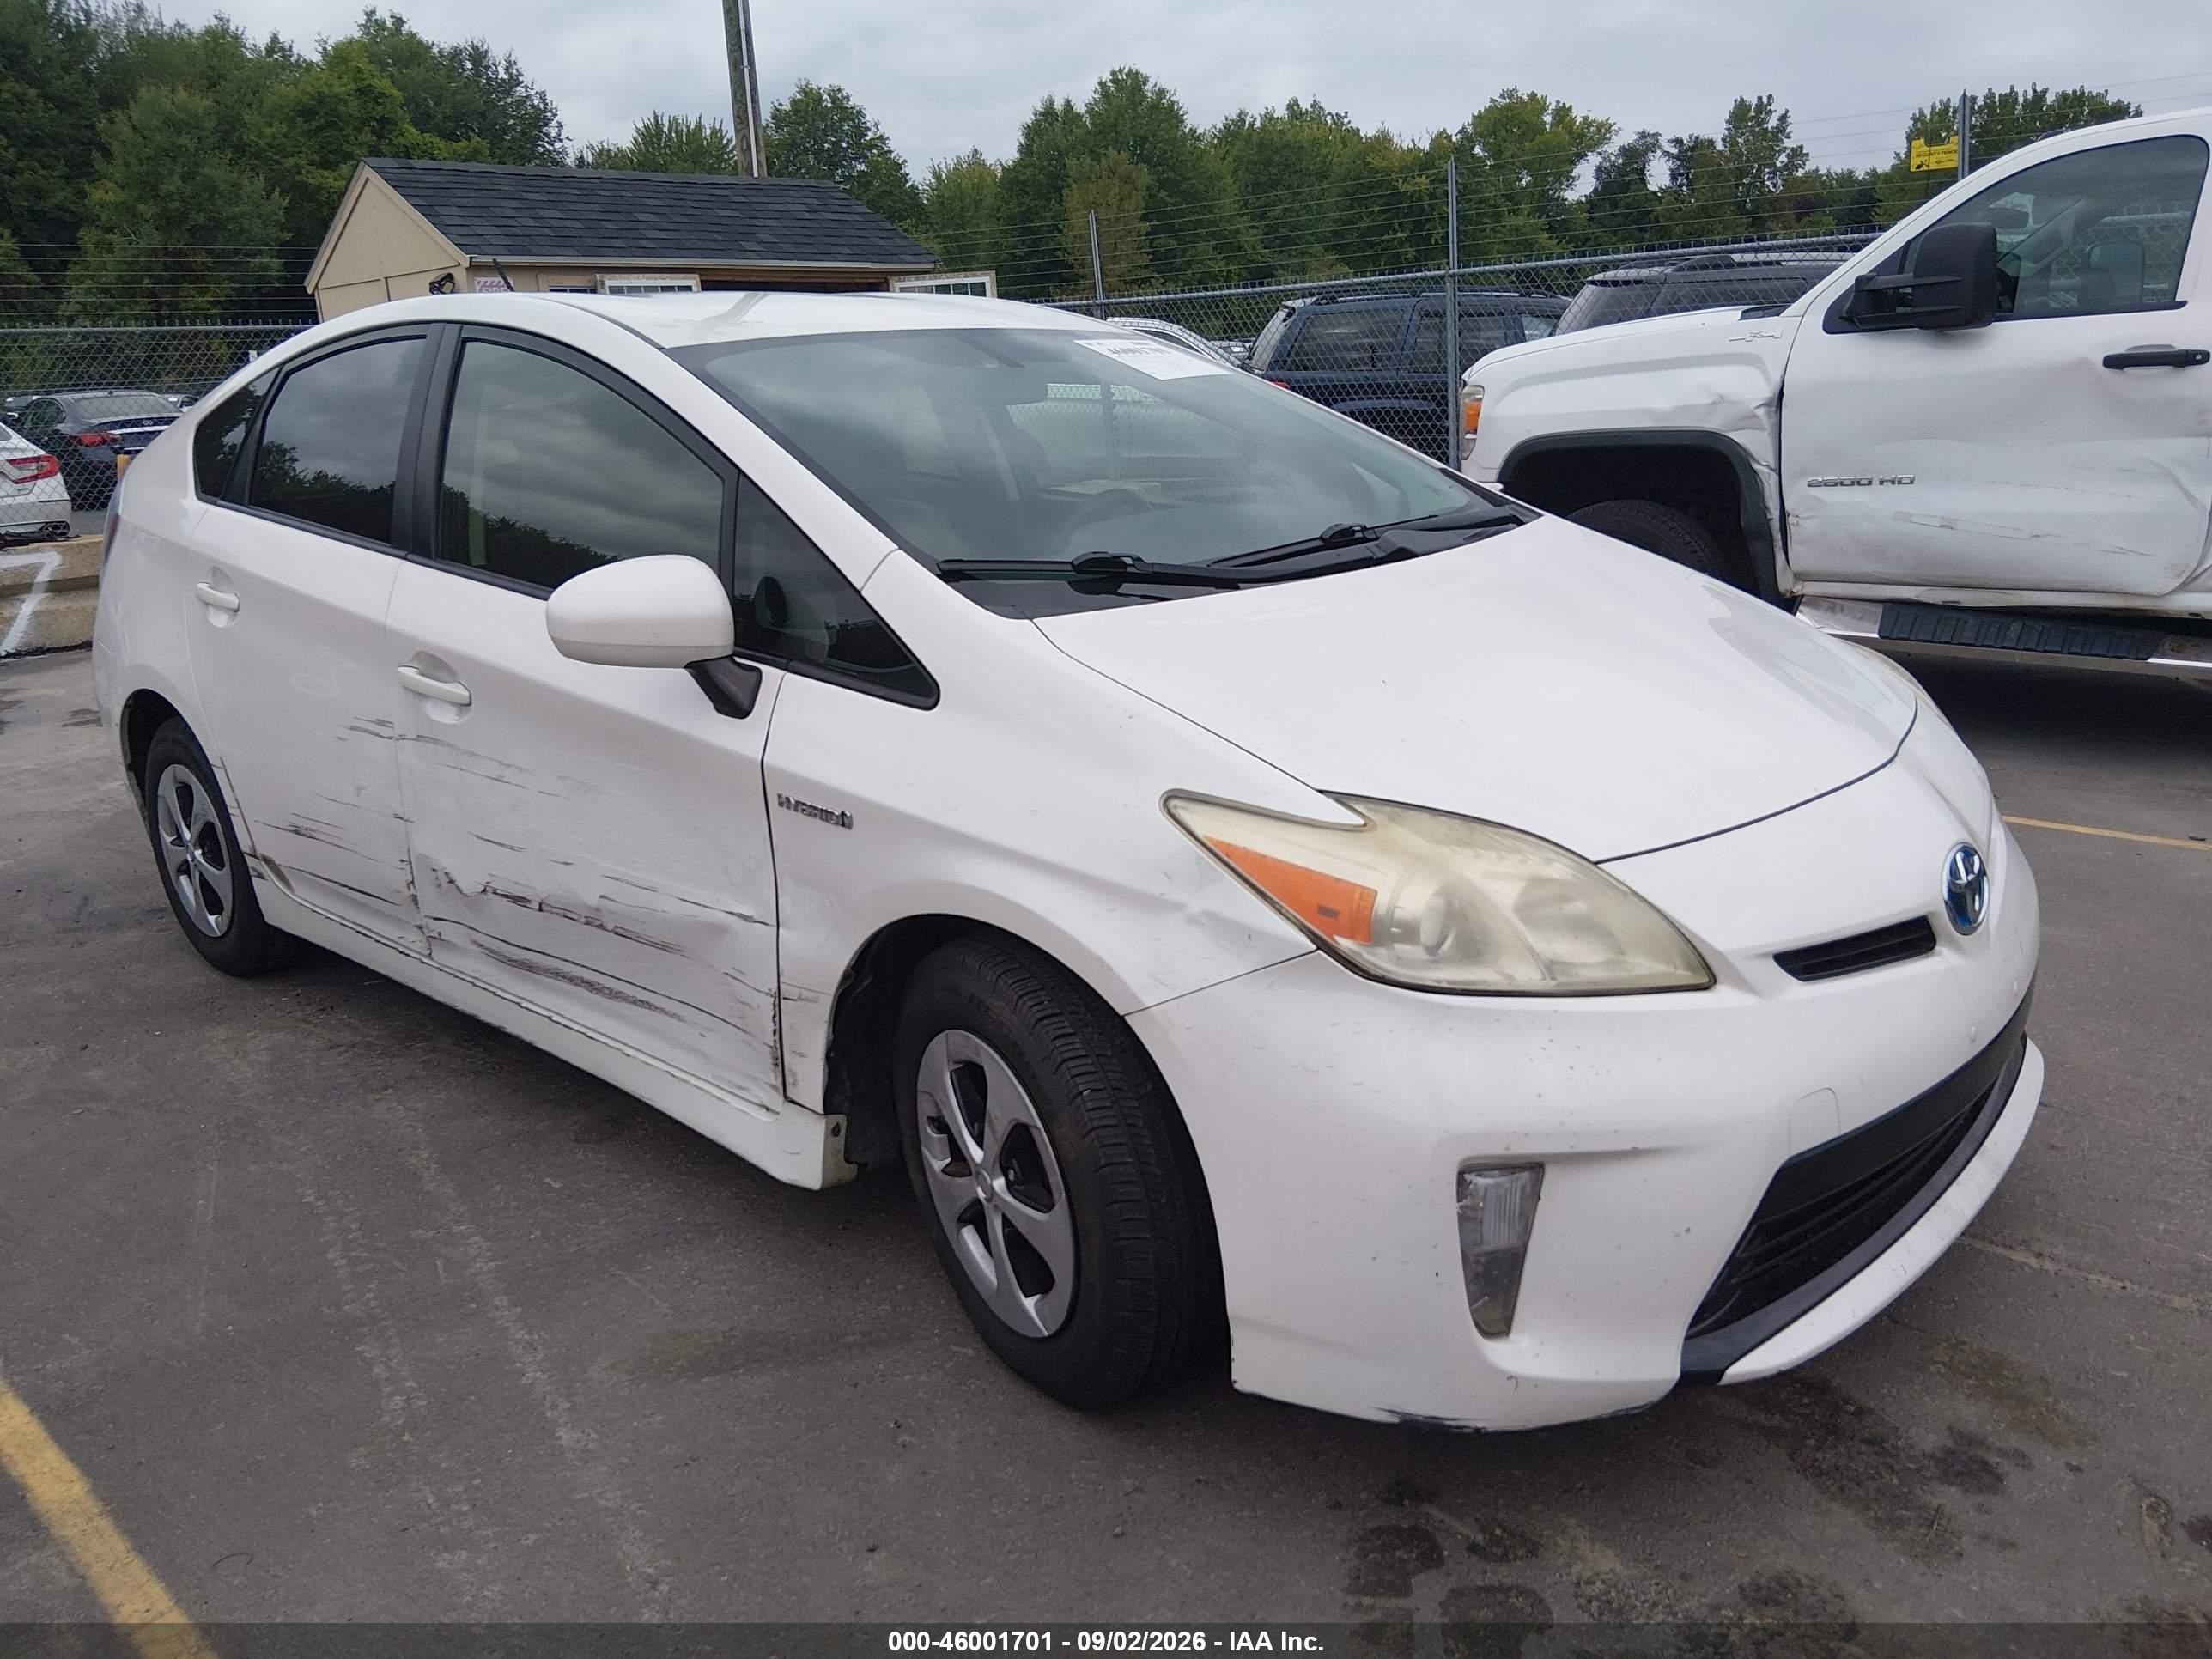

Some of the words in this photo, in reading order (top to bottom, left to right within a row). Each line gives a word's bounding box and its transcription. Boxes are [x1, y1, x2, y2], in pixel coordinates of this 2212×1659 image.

[1807, 477, 1874, 488] 2500
[1878, 475, 1916, 487] HD
[776, 793, 842, 826] HYBRID
